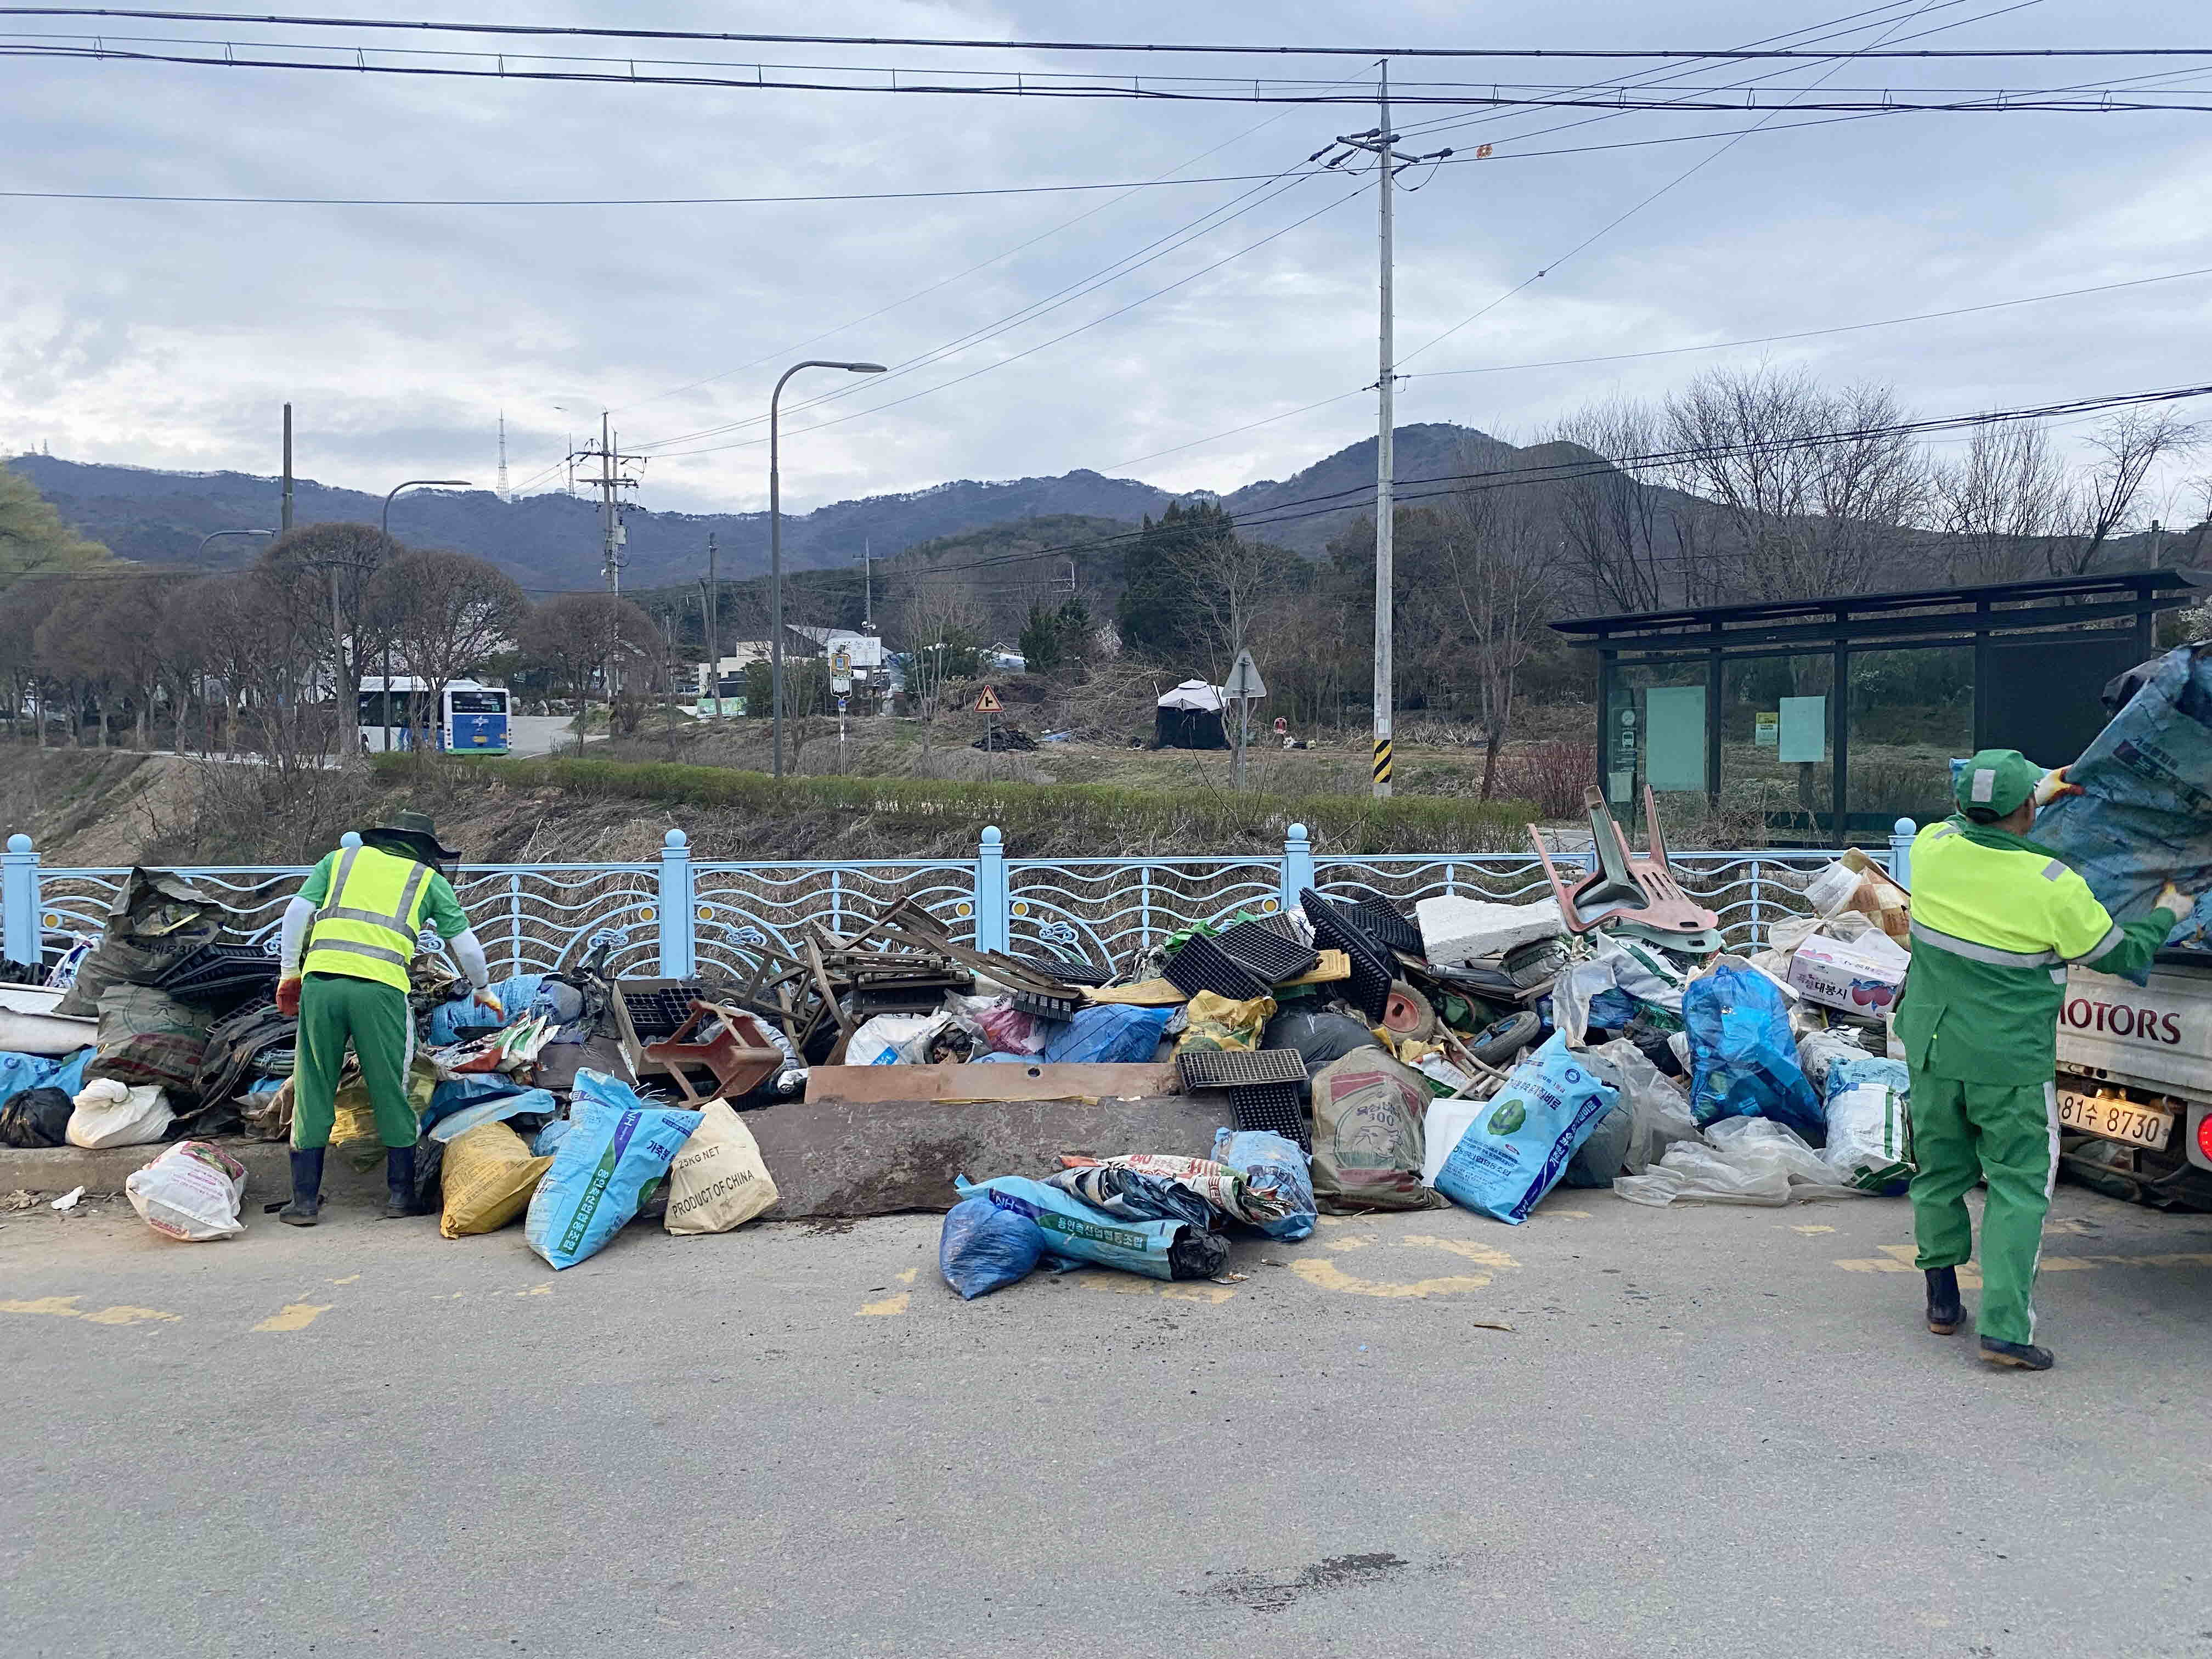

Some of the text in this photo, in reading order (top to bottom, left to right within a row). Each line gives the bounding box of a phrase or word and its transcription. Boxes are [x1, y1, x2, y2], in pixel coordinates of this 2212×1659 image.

[1814, 981, 1848, 1000] 대봉시
[2062, 1097, 2159, 1142] 81수 8730
[678, 1154, 702, 1169] 25KG
[702, 1146, 720, 1160] NET
[672, 1170, 755, 1218] PRODUCT OF CHINA
[995, 1195, 1015, 1210] NH
